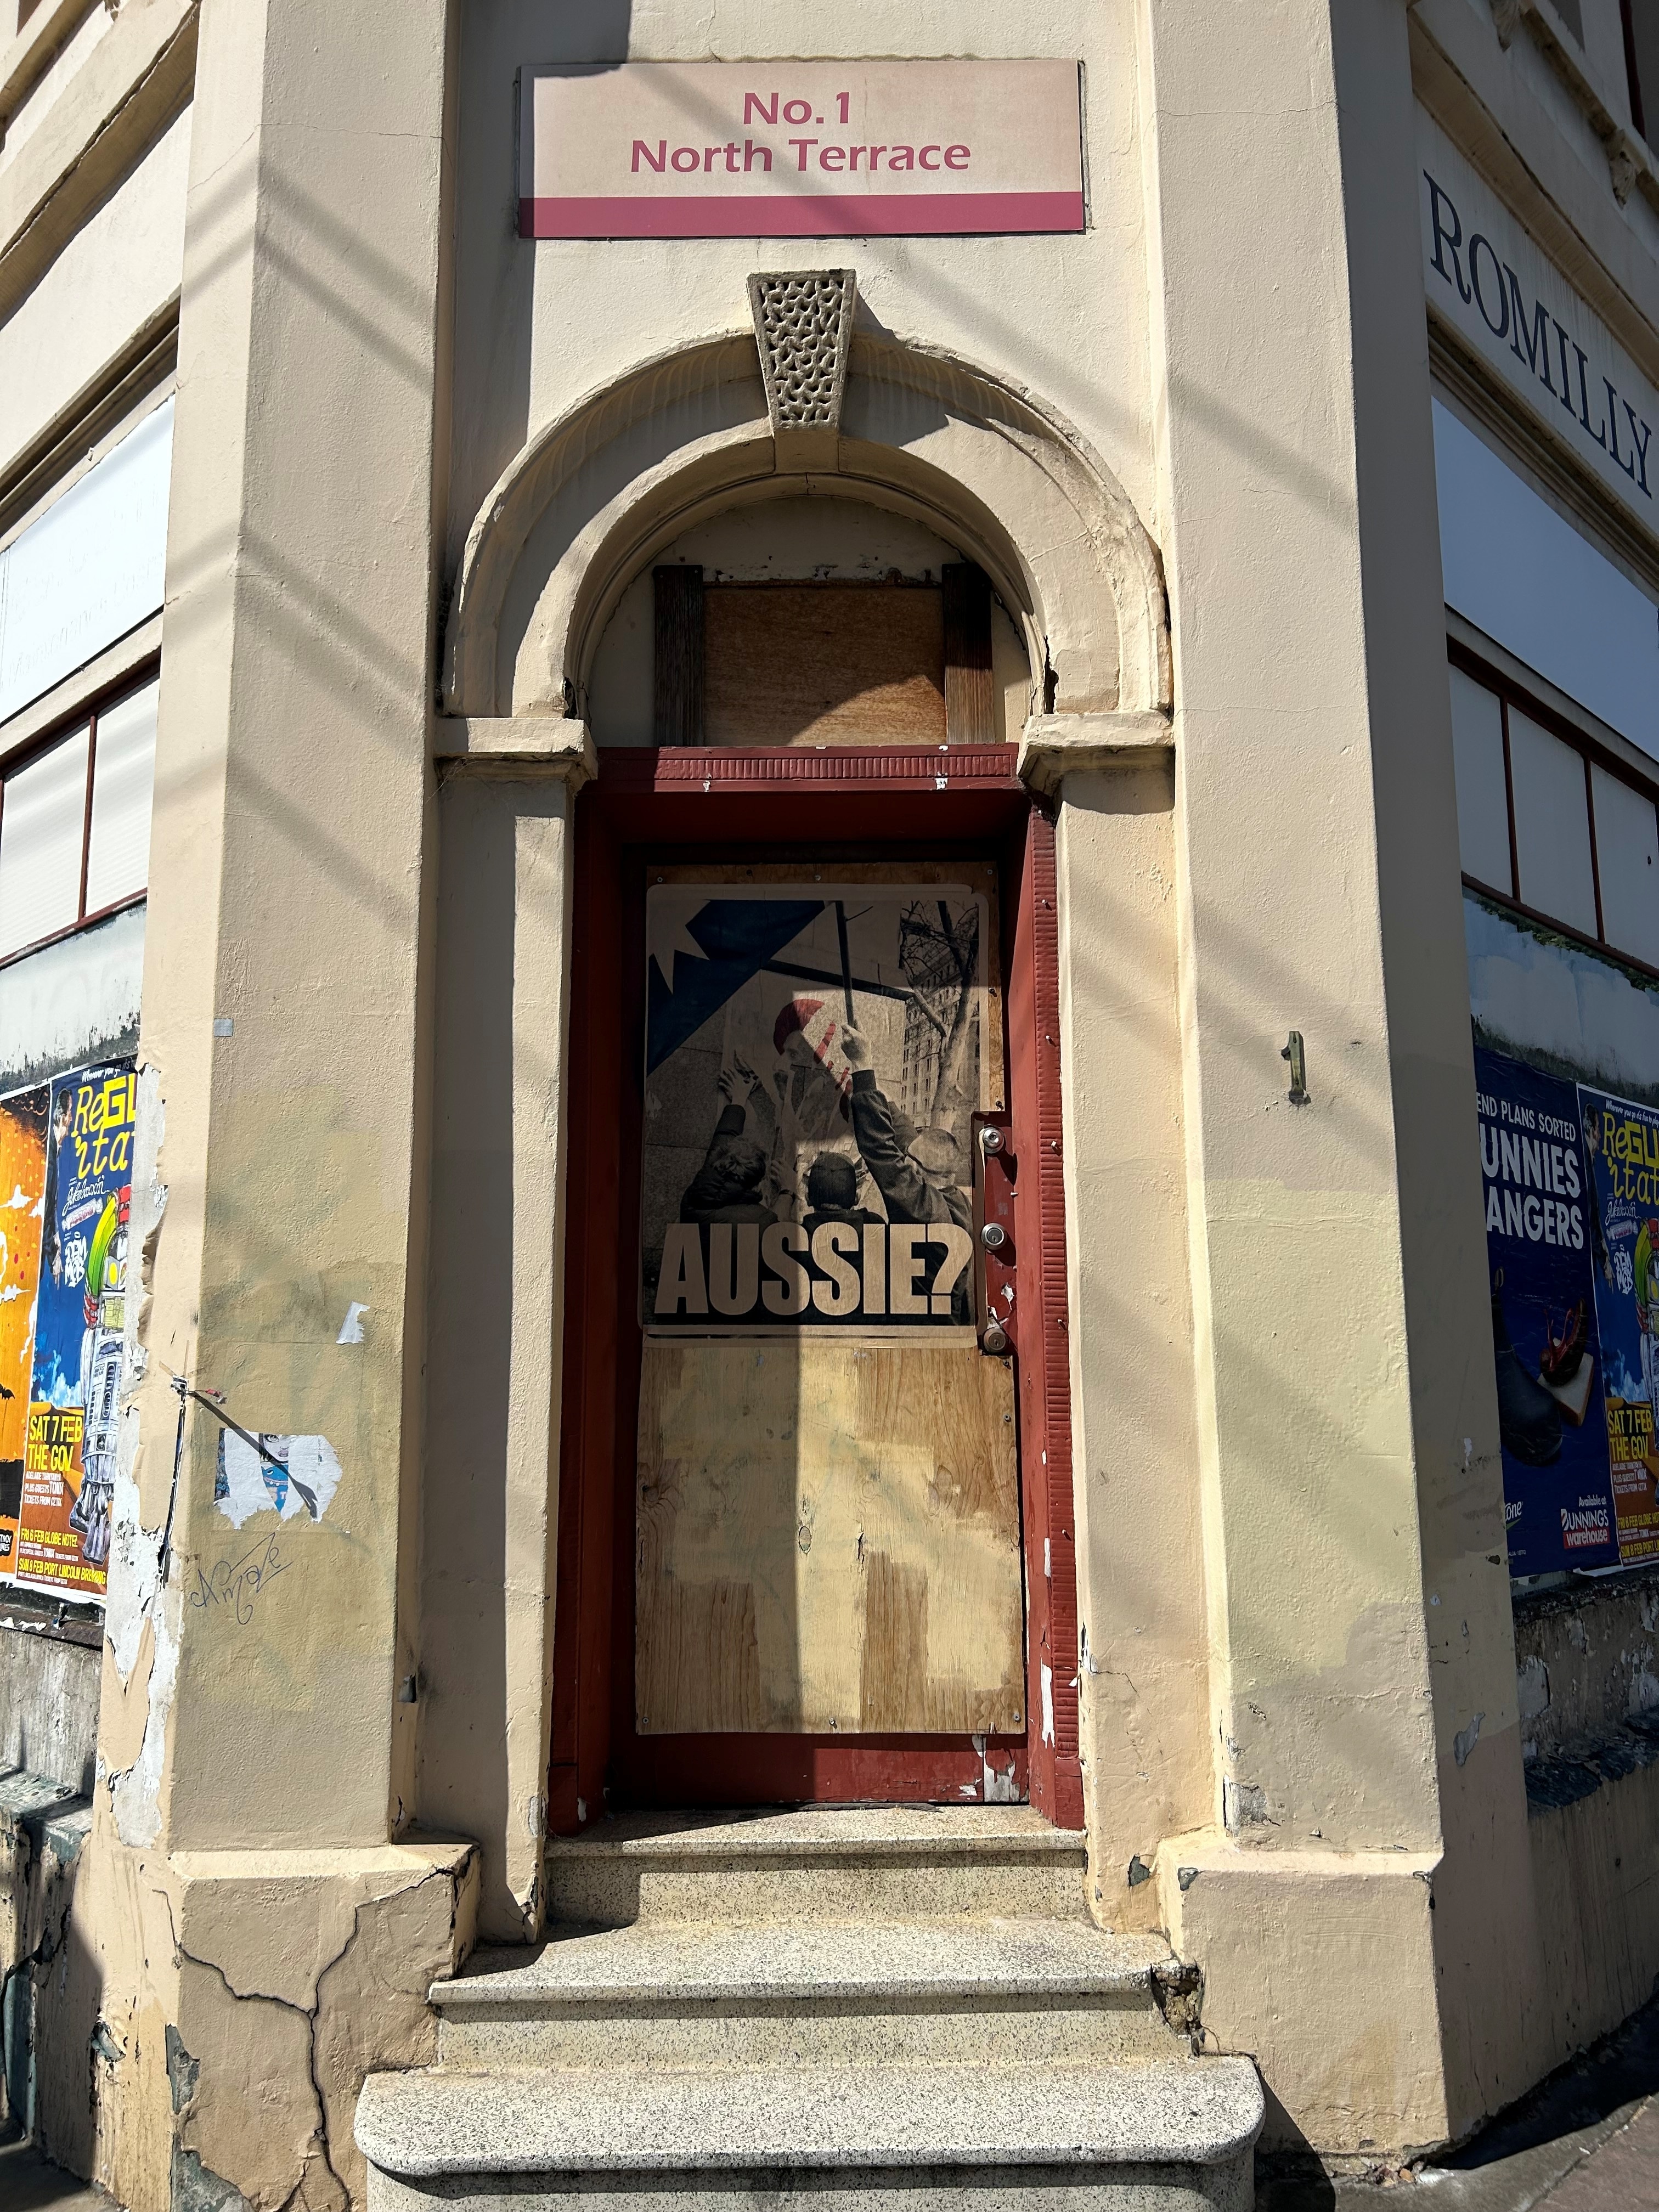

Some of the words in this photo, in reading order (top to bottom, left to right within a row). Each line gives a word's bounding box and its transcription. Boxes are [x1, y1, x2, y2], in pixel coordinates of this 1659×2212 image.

[743, 91, 850, 125] No.1
[631, 139, 772, 173] North
[789, 138, 972, 172] Terrace
[1423, 168, 1652, 499] ROMILLY
[1500, 1101, 1536, 1130] PLANS
[1538, 1113, 1576, 1142] SORTED
[1479, 1122, 1581, 1198] UNNIES
[1486, 1186, 1584, 1249] ANGERS
[654, 1221, 973, 1316] AUSSIE?
[29, 1415, 50, 1441] SAT
[52, 1415, 59, 1442] 7
[60, 1415, 83, 1442] FEB
[1607, 1410, 1624, 1435] SAT
[1626, 1410, 1632, 1433] 7
[1634, 1409, 1653, 1433] FEB
[28, 1443, 49, 1470] THE
[50, 1444, 74, 1471] GOV
[1610, 1436, 1630, 1462] THE
[1630, 1435, 1649, 1459] GOV
[25, 1483, 35, 1493] PLUS
[1578, 1494, 1601, 1507] Available
[1601, 1496, 1607, 1505] at
[1560, 1509, 1609, 1531] BUNNINGS
[1629, 1515, 1638, 1527] FEB
[21, 1528, 30, 1541] FRI
[30, 1529, 34, 1541] 6
[34, 1530, 44, 1543] FEB
[44, 1531, 63, 1545] GLOBE
[62, 1533, 78, 1548] HOTEL
[1566, 1527, 1608, 1546] warehouse
[1634, 1543, 1643, 1555] FEB
[19, 1558, 30, 1571] SUN
[30, 1560, 33, 1572] 8
[33, 1560, 43, 1574] FEB
[44, 1562, 58, 1577] PORT
[58, 1564, 81, 1580] LINCOLN
[81, 1567, 106, 1585] BREWING
